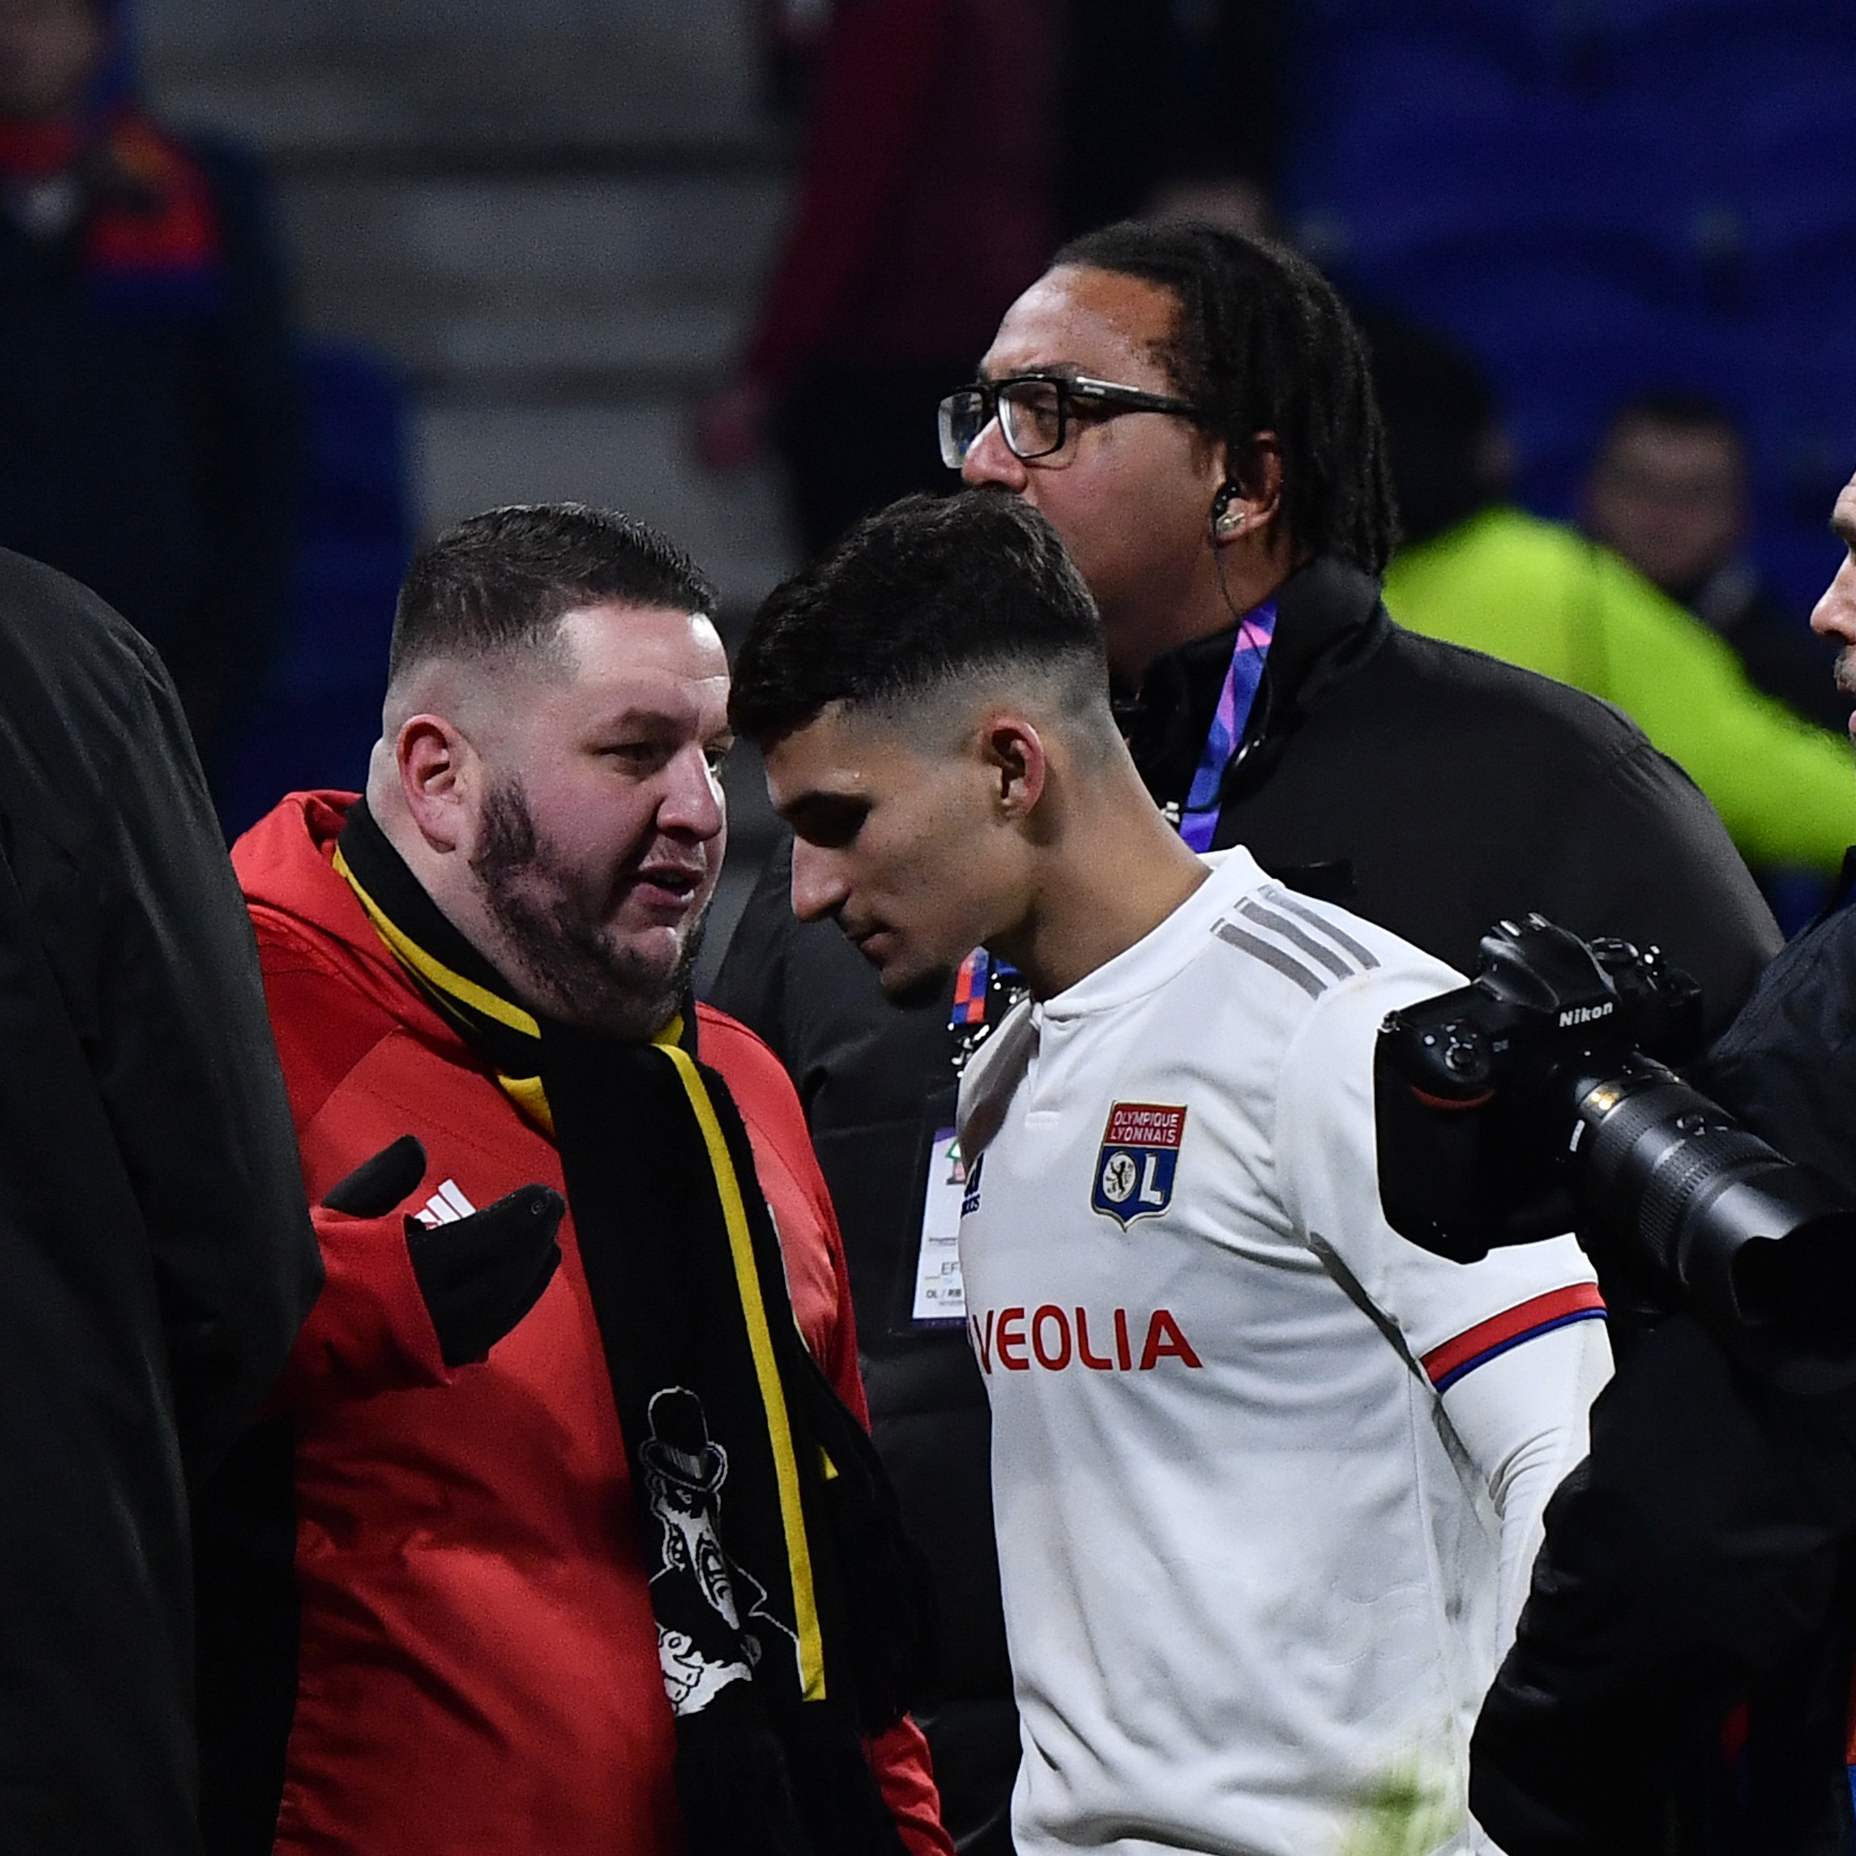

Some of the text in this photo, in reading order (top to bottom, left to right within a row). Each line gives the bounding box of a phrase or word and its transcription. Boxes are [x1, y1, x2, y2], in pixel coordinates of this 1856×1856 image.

[1559, 1001, 1613, 1028] Nikon
[1114, 1110, 1180, 1128] OLYMPIQUE
[1109, 1126, 1177, 1144] LYONNAIS
[972, 1304, 1204, 1375] VEOLIA
